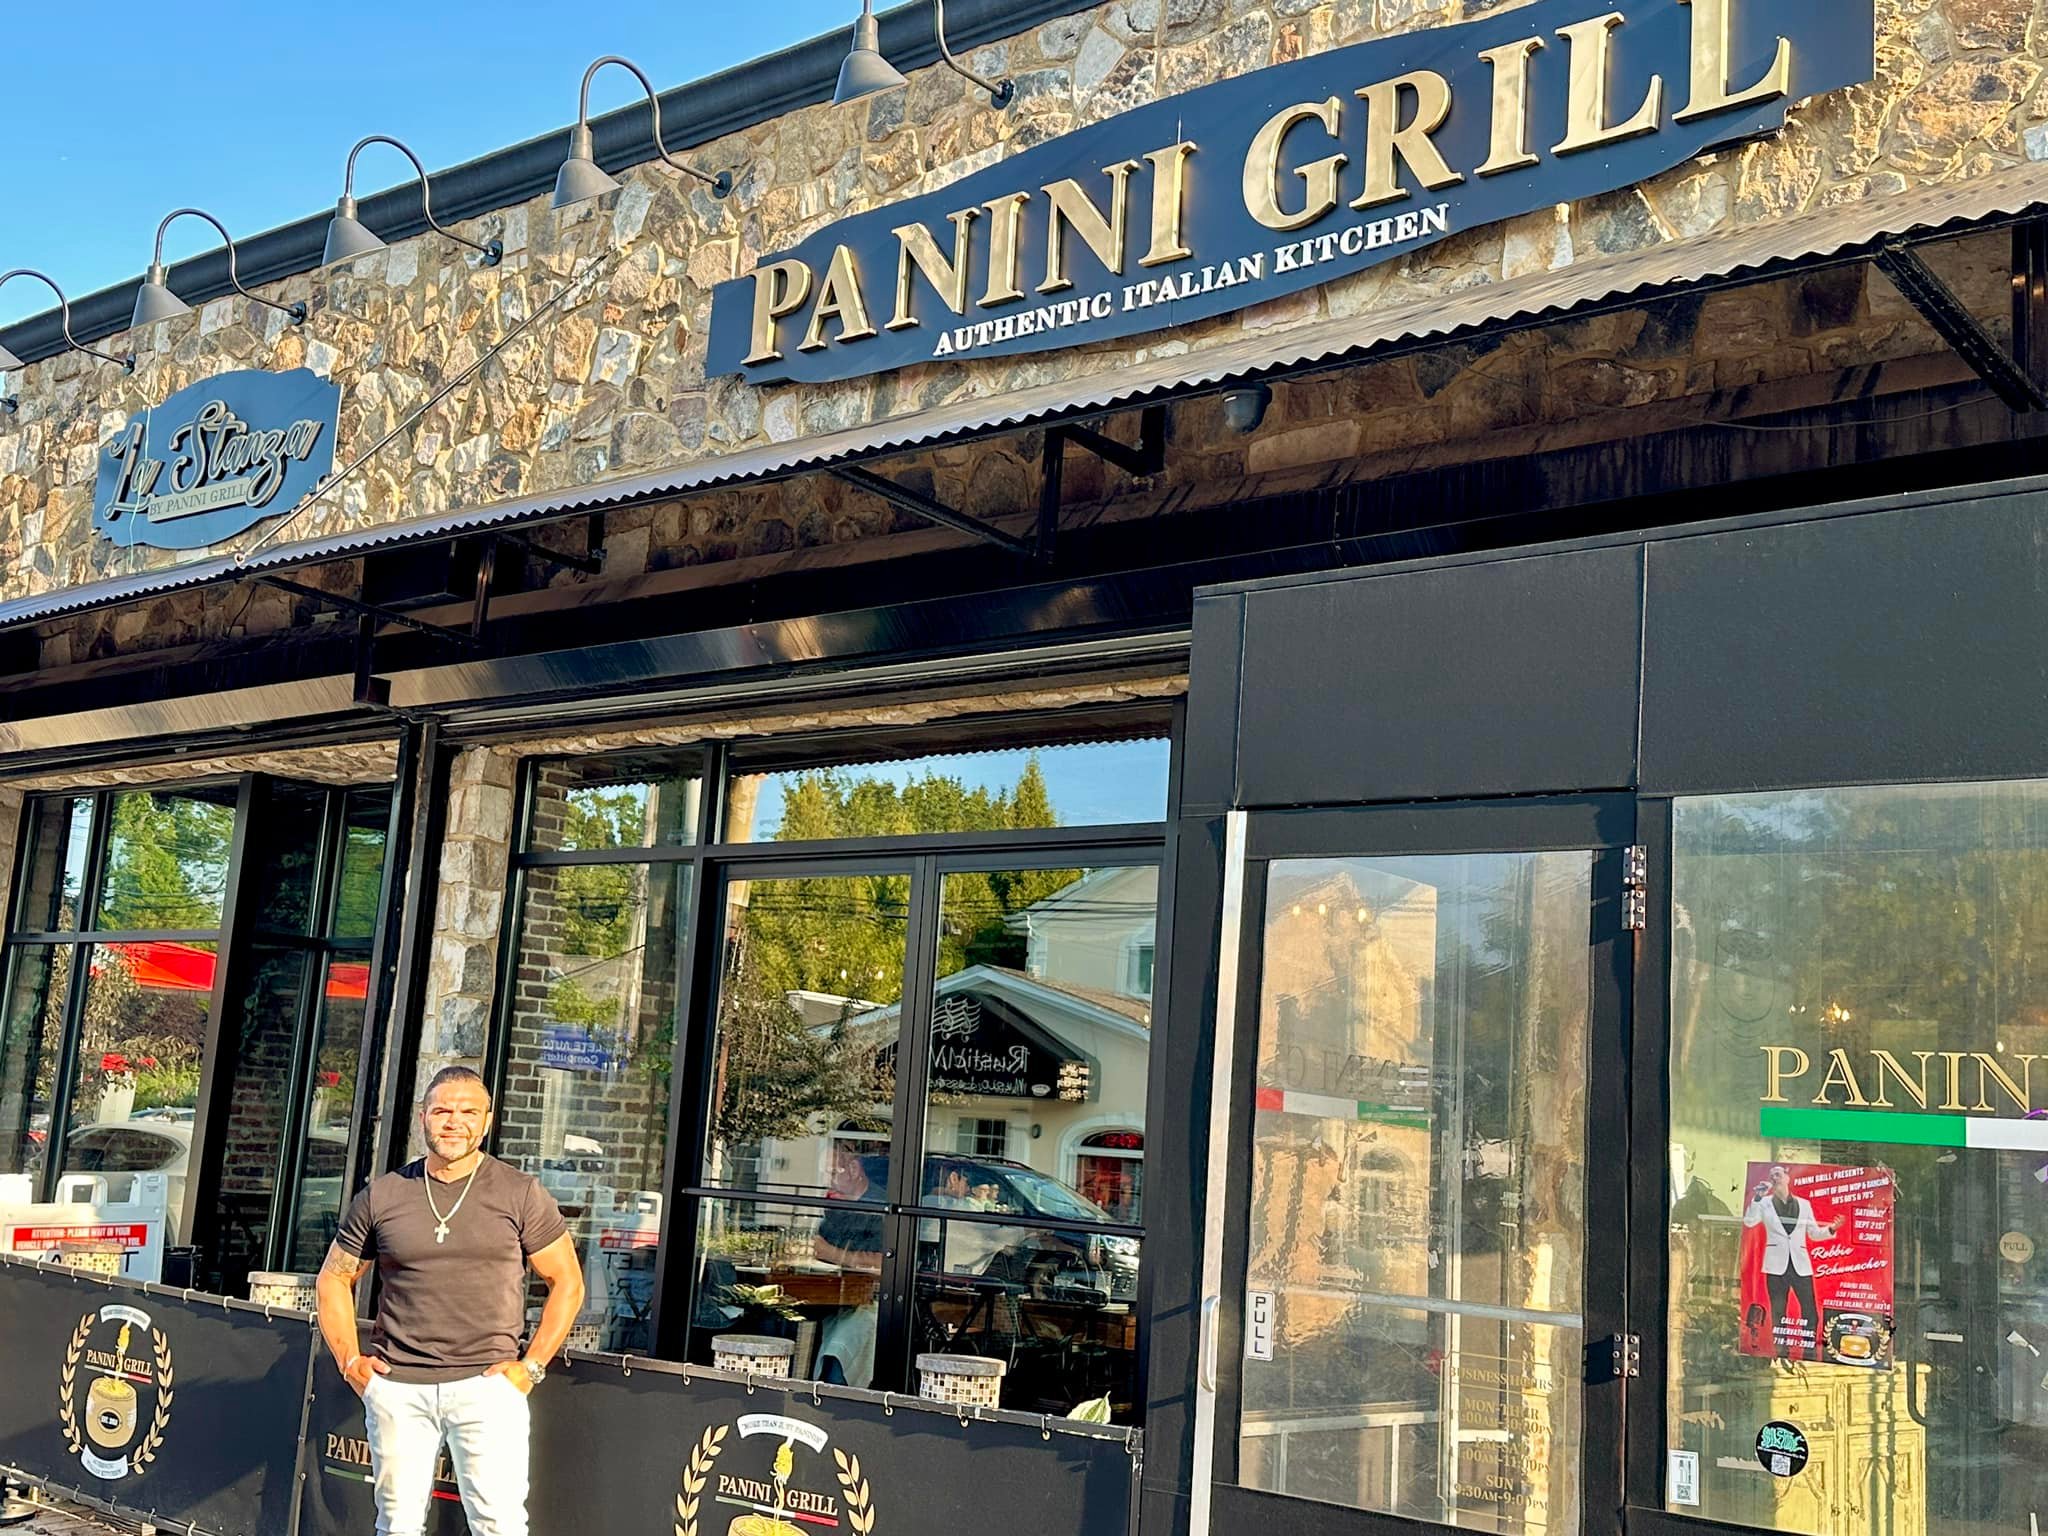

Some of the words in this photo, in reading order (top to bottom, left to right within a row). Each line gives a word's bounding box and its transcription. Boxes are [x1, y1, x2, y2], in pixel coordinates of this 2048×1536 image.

[741, 140, 1197, 366] PANINI
[1243, 0, 1790, 231] GRILL
[933, 293, 1112, 355] AUTHENTIC
[1122, 252, 1264, 312] ITALIAN
[1273, 203, 1450, 274] KITCHEN
[103, 421, 164, 520] La
[168, 400, 324, 507] Stanza
[150, 502, 165, 516] BY
[167, 492, 207, 513] PANINI
[210, 483, 247, 503] GRILL
[1760, 1046, 2048, 1113] PANIN
[1794, 1176, 1815, 1186] PANINI
[1815, 1173, 1832, 1183] GRILL
[1833, 1167, 1864, 1180] PRESENTS
[1854, 1220, 1870, 1229] SEPT
[1811, 1243, 1854, 1259] Robbie
[1813, 1257, 1888, 1278] Schumacher
[1254, 1296, 1266, 1354] PULL
[1780, 1316, 1795, 1325] CALL
[1795, 1318, 1808, 1326] FOR
[85, 1350, 116, 1369] PANINI
[124, 1359, 153, 1376] GRILL
[326, 1433, 374, 1466] PANI
[718, 1474, 772, 1503] PANINI
[786, 1490, 839, 1516] GRILL
[1486, 1474, 1514, 1490] SUN
